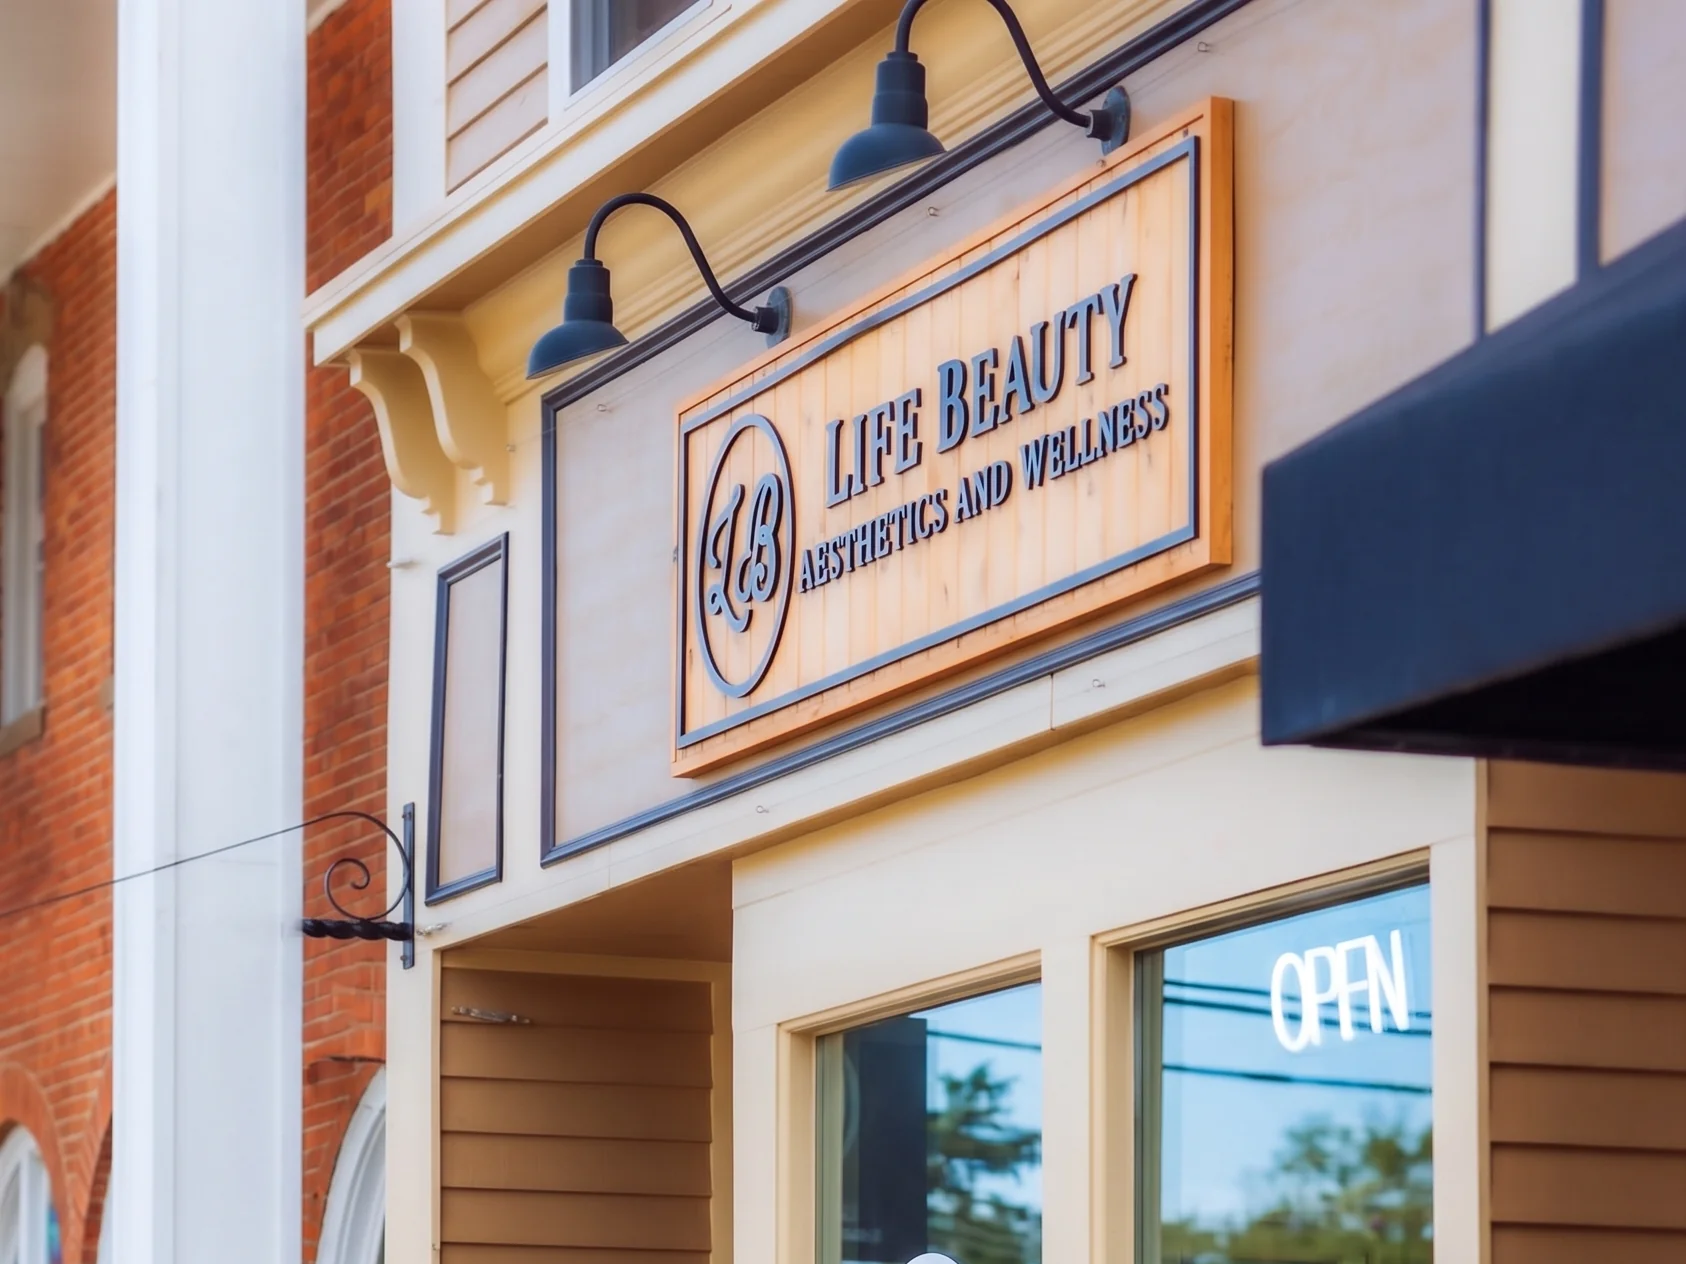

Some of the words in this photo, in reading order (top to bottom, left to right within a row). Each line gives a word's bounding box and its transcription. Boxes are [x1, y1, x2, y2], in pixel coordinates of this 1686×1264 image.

[798, 488, 949, 594] AESTHETICS
[954, 459, 1013, 524] AND
[1019, 382, 1170, 490] WELLNESS
[826, 387, 922, 508] LIFE
[937, 273, 1138, 454] BEAUTY
